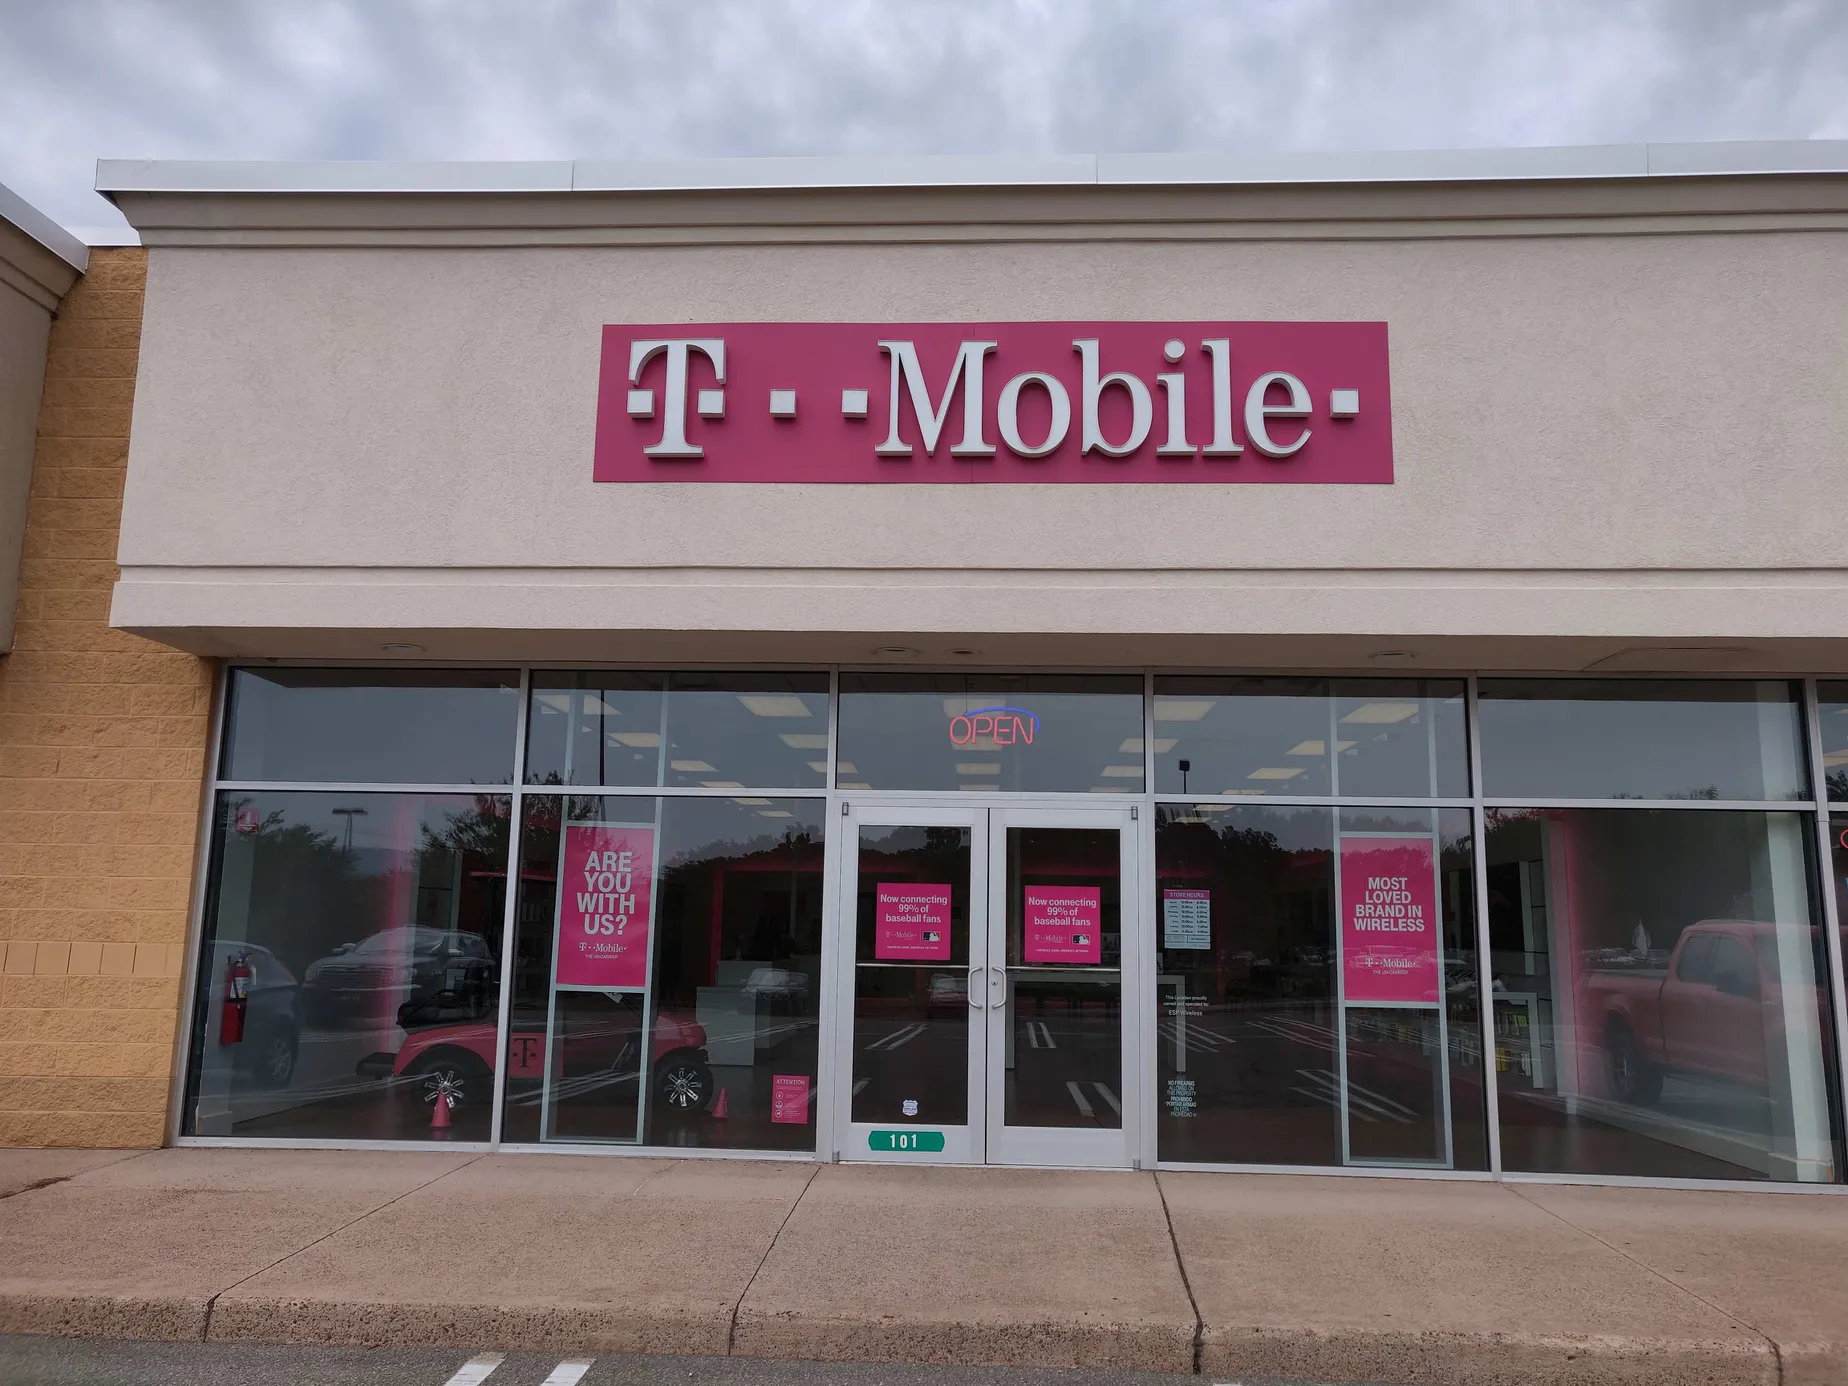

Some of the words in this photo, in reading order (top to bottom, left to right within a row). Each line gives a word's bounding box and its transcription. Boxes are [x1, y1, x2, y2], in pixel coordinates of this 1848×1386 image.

[949, 716, 1034, 745] OPEN
[584, 851, 632, 872] ARE
[584, 872, 632, 893] YOU
[1368, 877, 1408, 890] MOST
[576, 892, 636, 914] WITH
[880, 894, 899, 903] Now
[900, 895, 948, 905] connecting
[1028, 897, 1047, 905] Now
[1048, 898, 1096, 908] connecting
[1366, 890, 1412, 904] LOVED
[898, 904, 919, 913] 99%
[920, 904, 929, 913] of
[1047, 907, 1068, 916] 99%
[1069, 907, 1078, 916] of
[1355, 904, 1405, 918] BRAND
[1408, 905, 1422, 918] IN
[584, 914, 628, 936] US?
[886, 913, 921, 922] baseball
[922, 914, 942, 923] fans
[1034, 916, 1070, 925] baseball
[1072, 917, 1091, 926] fans
[1354, 918, 1425, 932] WIRELESS
[890, 1134, 916, 1148] 101
